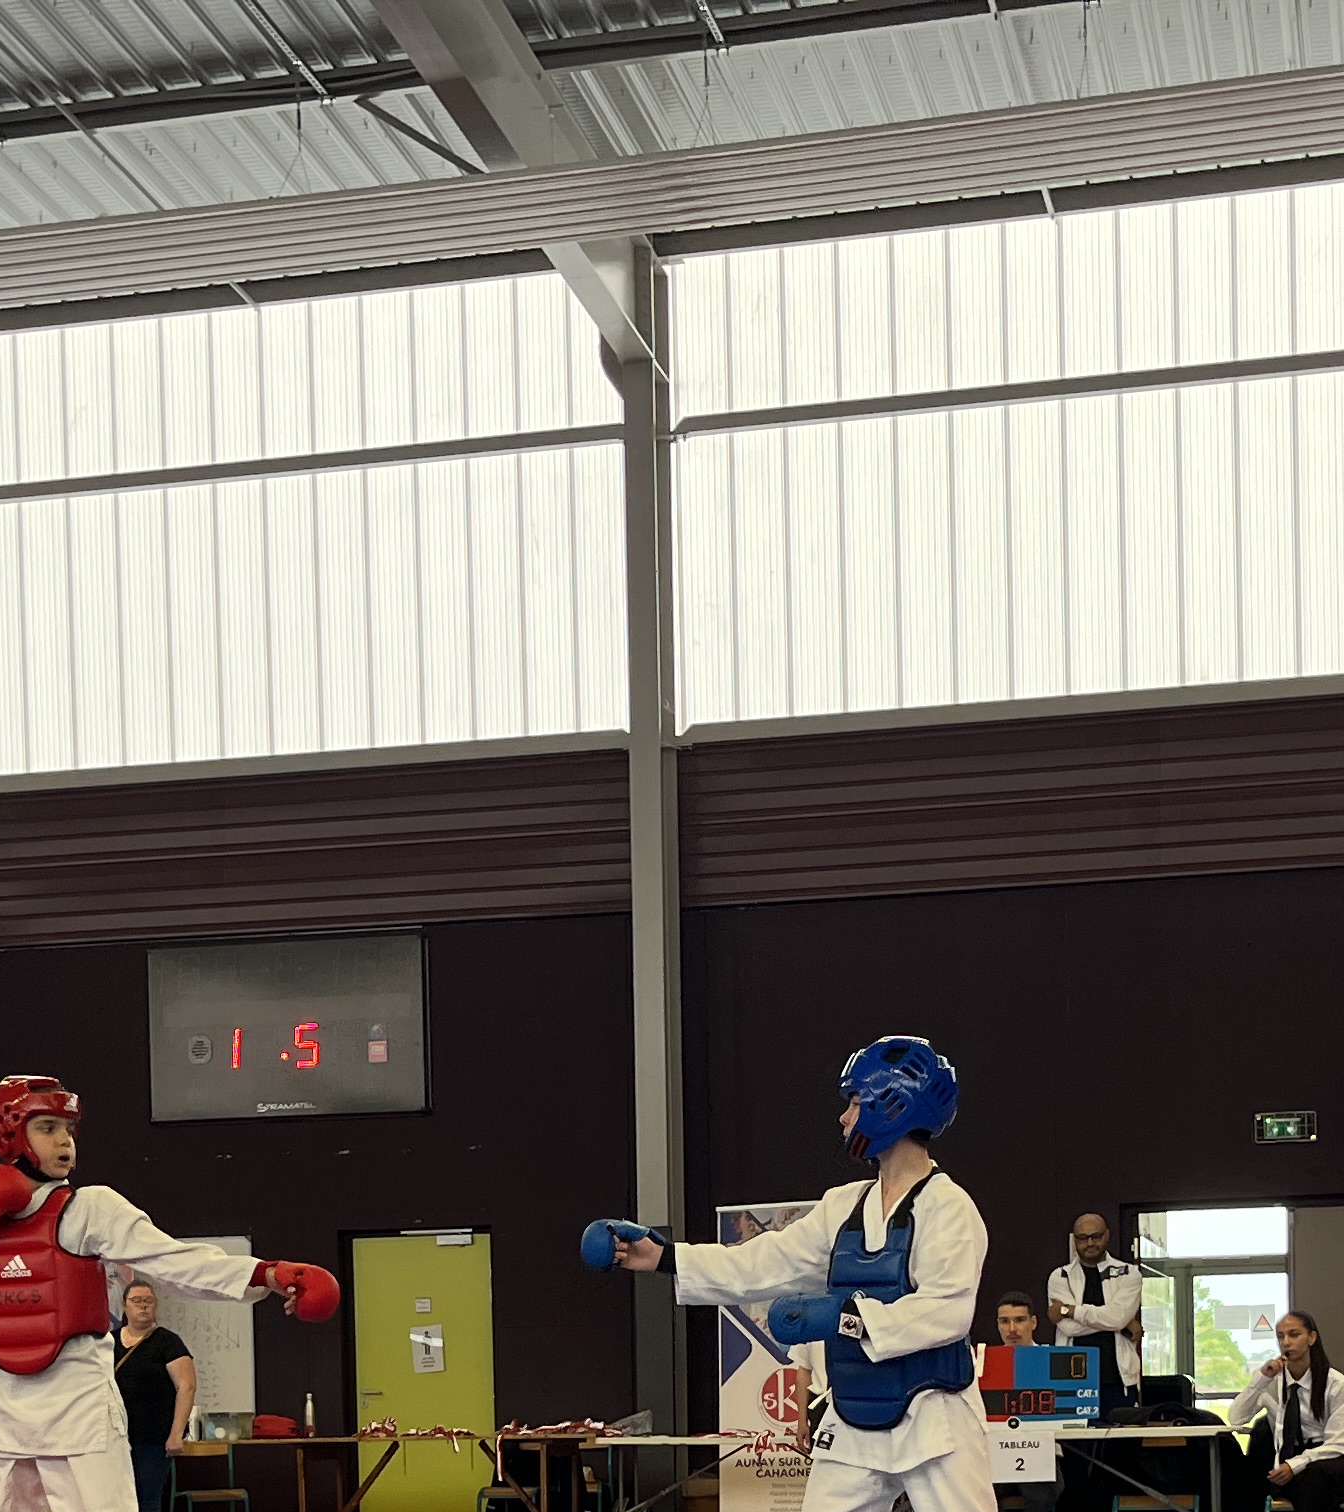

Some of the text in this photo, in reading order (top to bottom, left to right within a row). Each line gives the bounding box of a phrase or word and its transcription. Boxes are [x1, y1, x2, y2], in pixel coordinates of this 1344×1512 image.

[999, 1441, 1040, 1449] TABLEAU
[778, 1457, 801, 1467] SUR
[1015, 1458, 1025, 1471] 2
